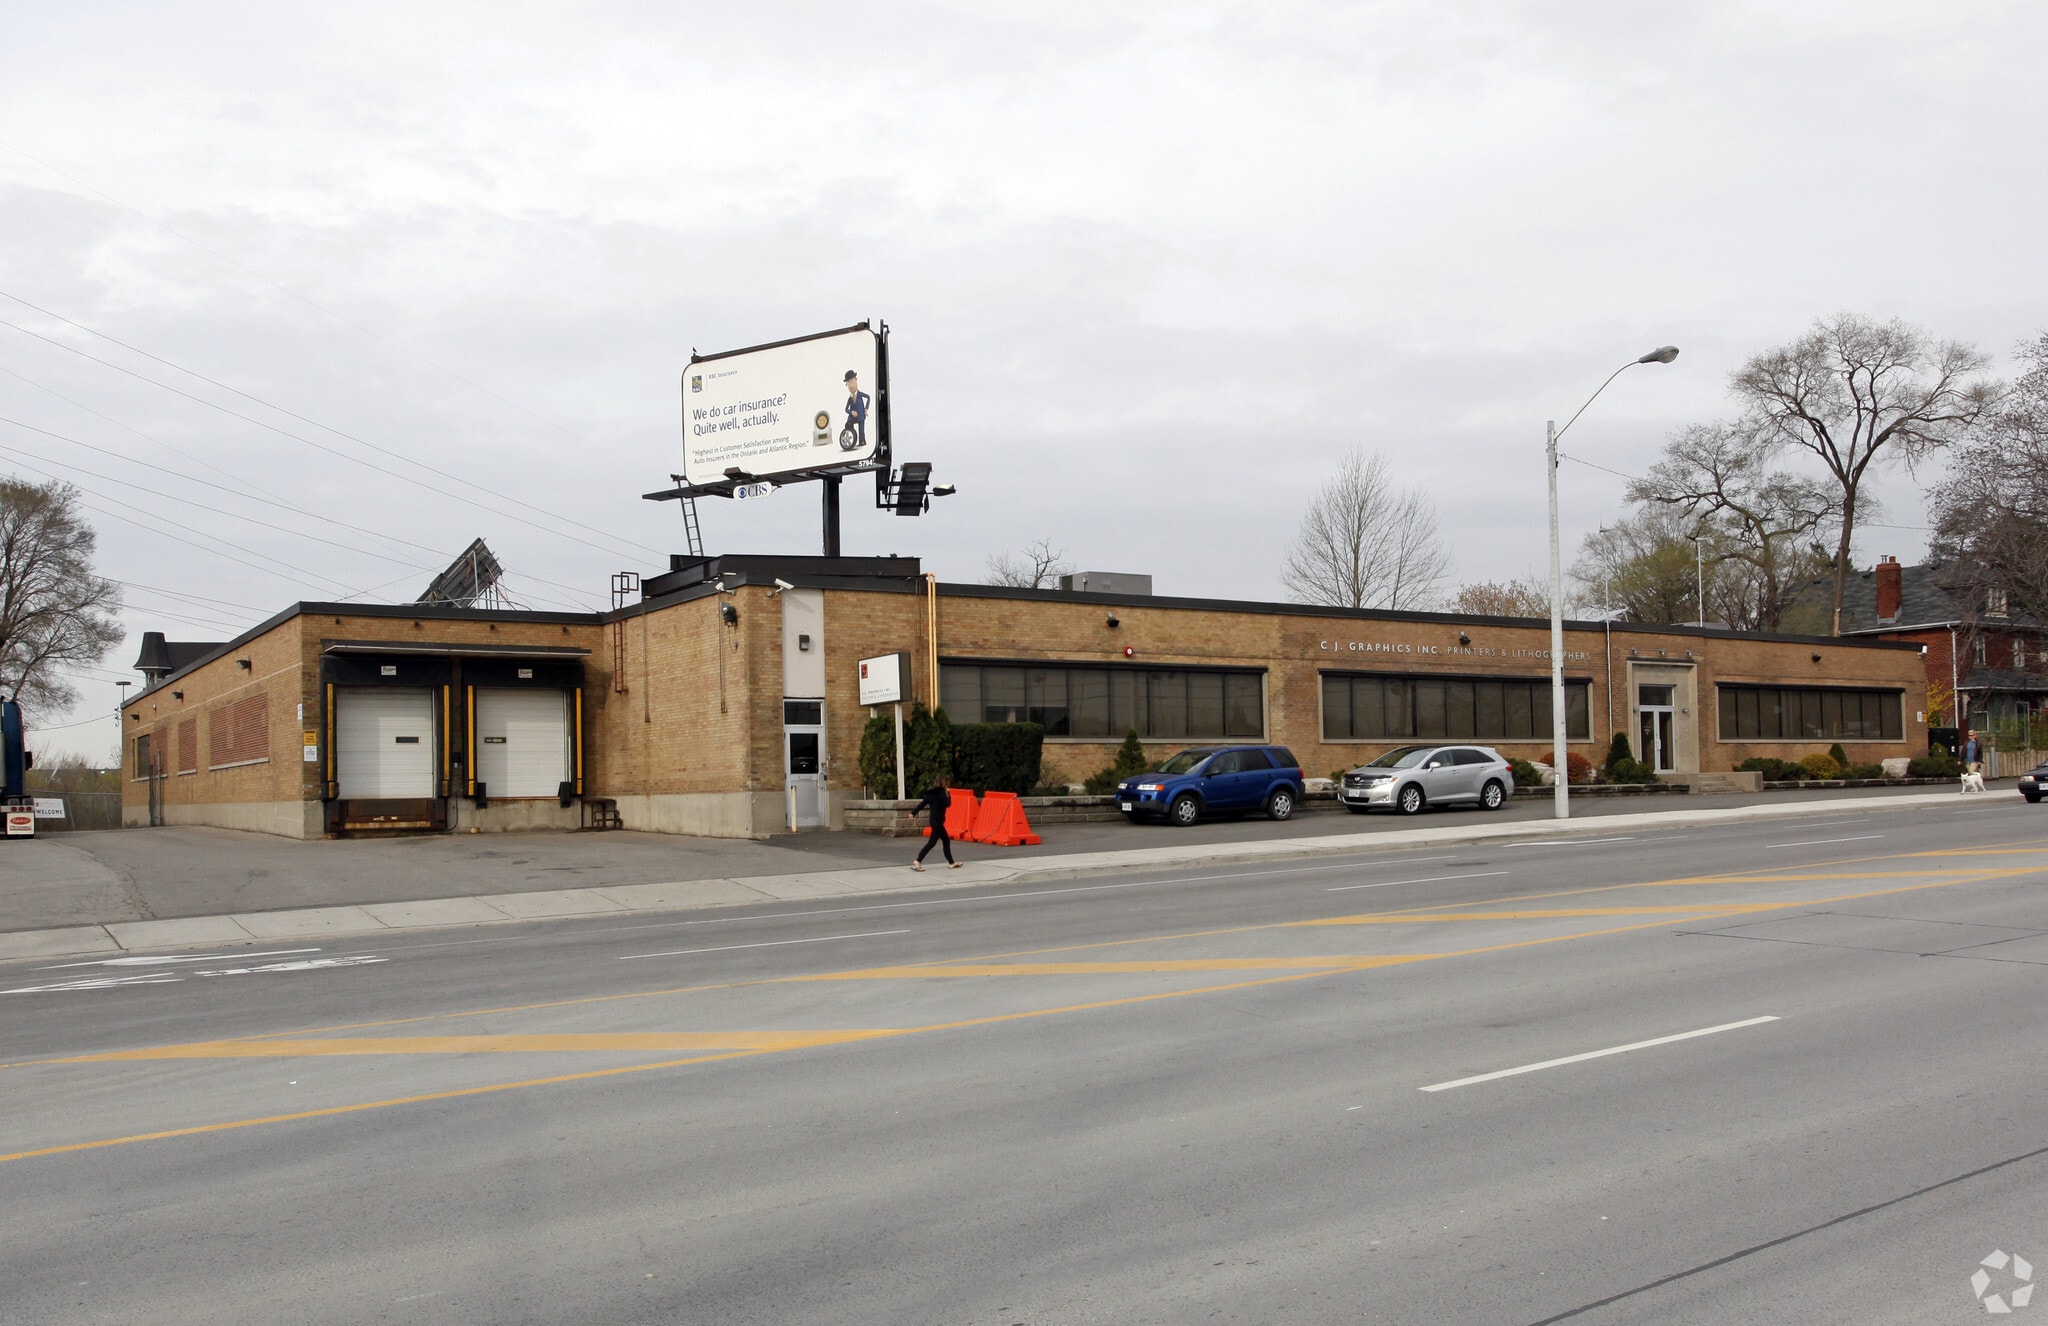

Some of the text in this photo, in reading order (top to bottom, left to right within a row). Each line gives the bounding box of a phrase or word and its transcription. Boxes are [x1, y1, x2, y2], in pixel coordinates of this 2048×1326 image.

[693, 393, 787, 420] We do car insurance?
[693, 411, 779, 436] Quite well, actually.
[720, 444, 742, 452] Customer
[743, 439, 771, 449] Satisfaction
[706, 455, 725, 463] Insurers
[740, 449, 758, 457] Ontario
[759, 446, 768, 454] and
[748, 484, 768, 497] CBS
[1349, 642, 1411, 653] GRAPHICS
[1447, 646, 1496, 657] PRINTERS
[1501, 649, 1506, 657] &
[1512, 649, 1591, 660] LITHOGPHERS
